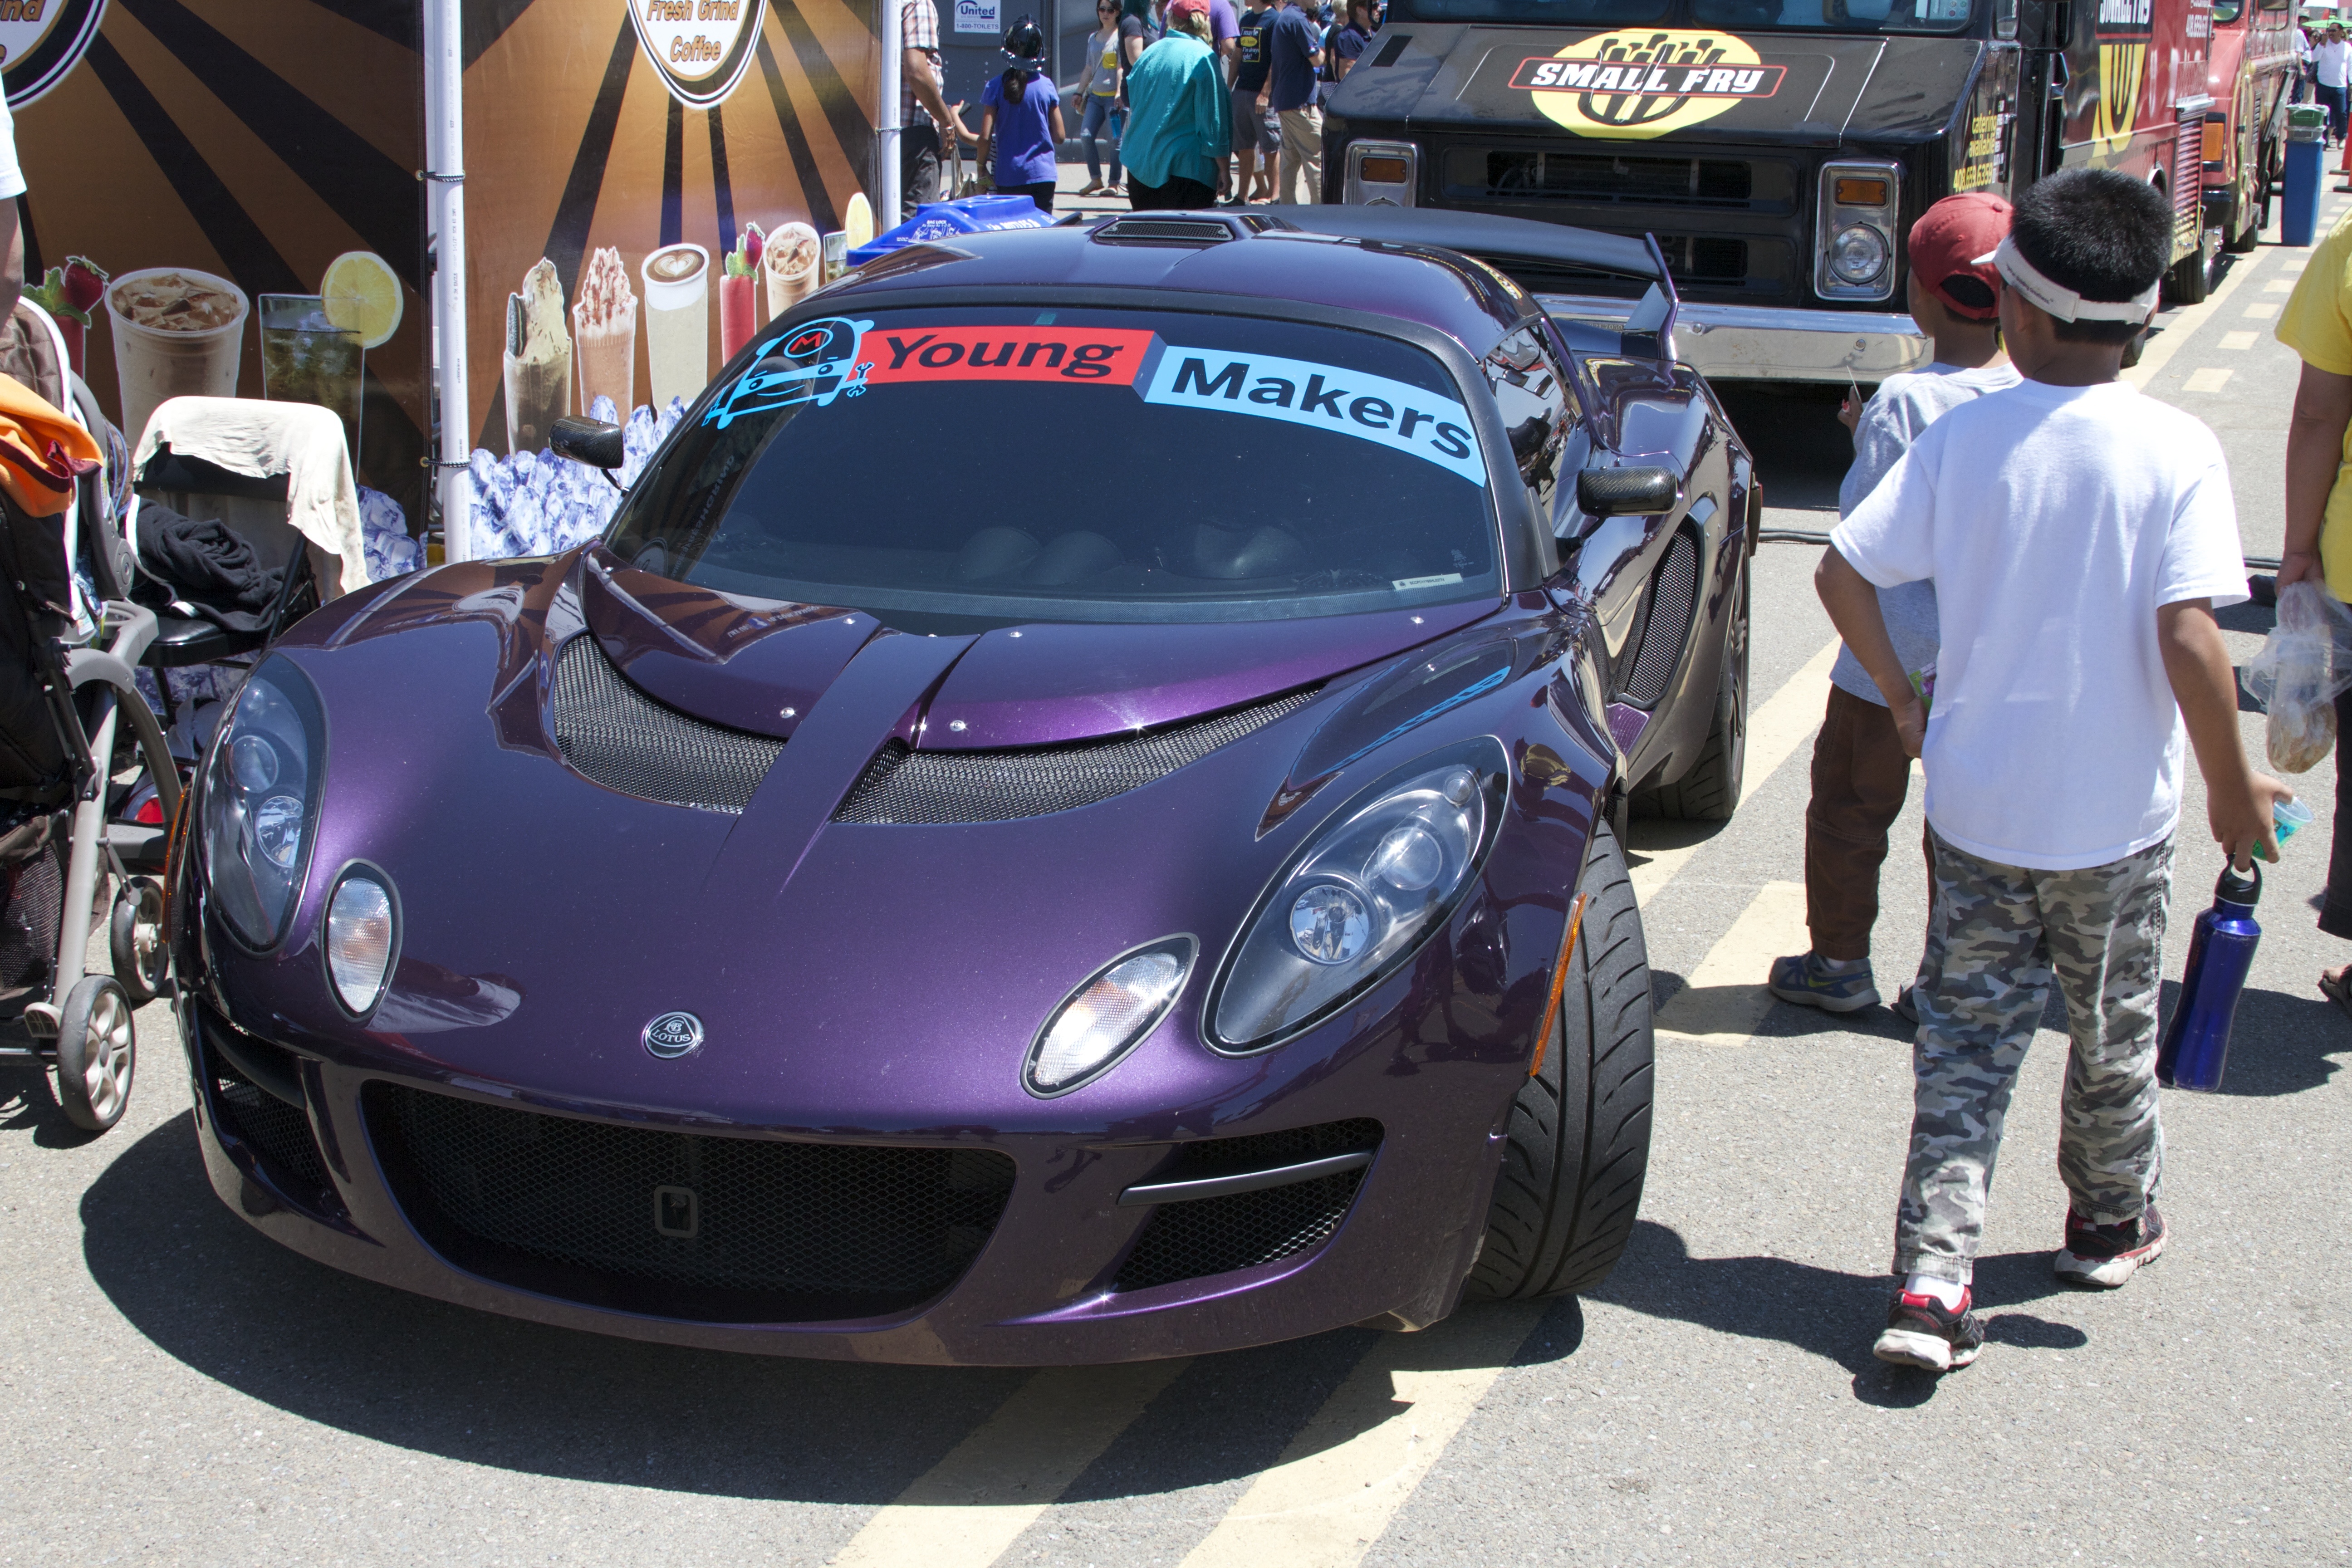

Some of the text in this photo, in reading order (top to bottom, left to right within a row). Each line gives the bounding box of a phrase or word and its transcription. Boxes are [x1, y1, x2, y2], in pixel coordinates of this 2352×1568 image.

[647, 0, 740, 21] Fresh Grind
[960, 5, 995, 15] United
[670, 35, 721, 62] Coffee
[1531, 63, 1764, 93] SMALL FRY
[1972, 109, 1997, 135] catering
[1969, 132, 1996, 158] available
[1953, 162, 1993, 193] 408.659.6359
[886, 334, 1472, 459] Young Makers
[652, 1029, 691, 1043] LOTUS
